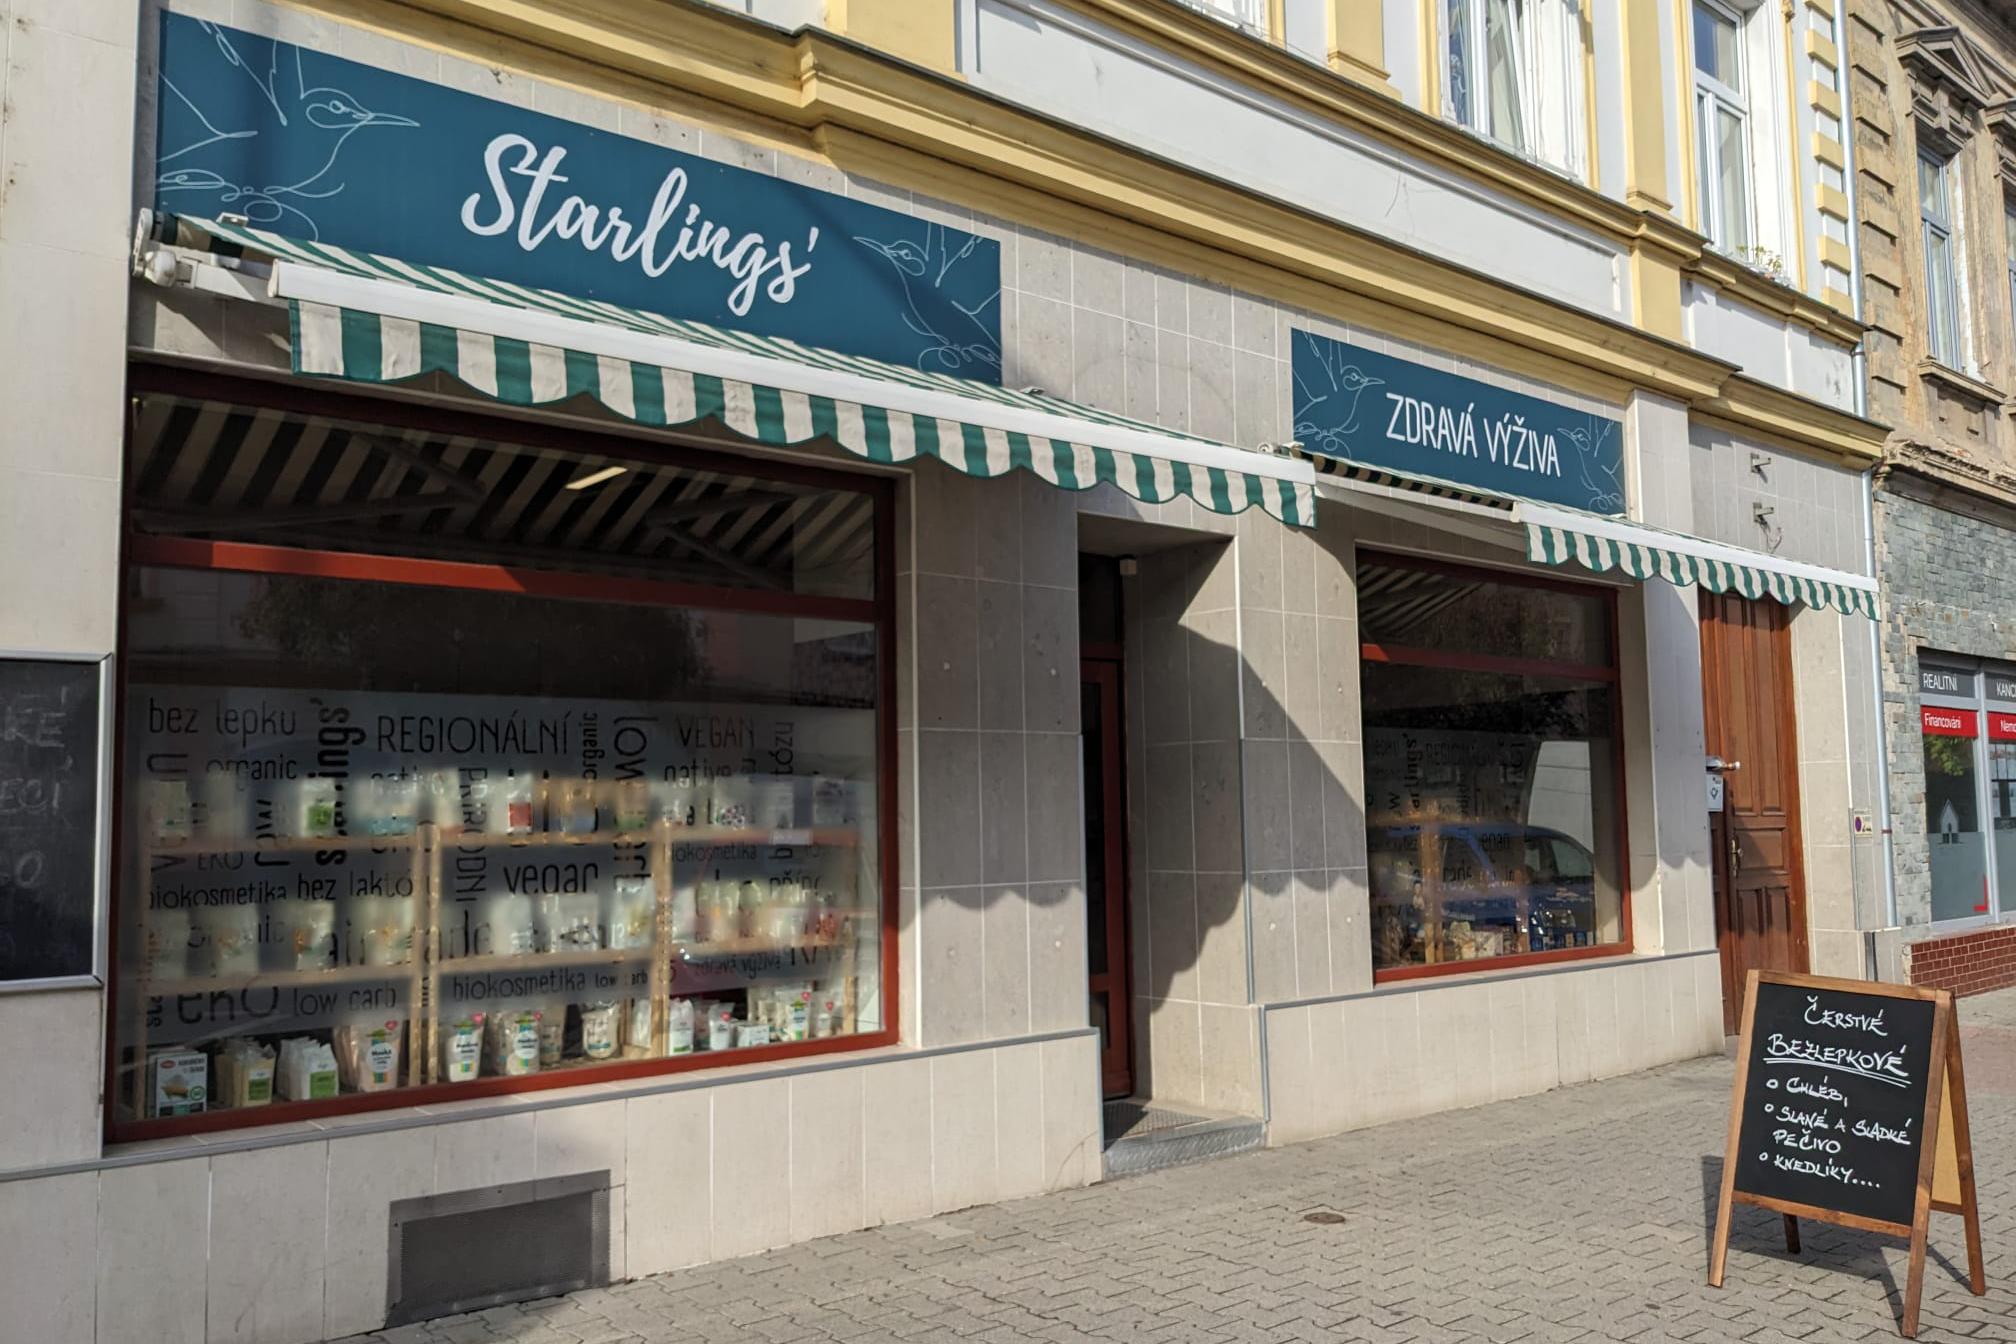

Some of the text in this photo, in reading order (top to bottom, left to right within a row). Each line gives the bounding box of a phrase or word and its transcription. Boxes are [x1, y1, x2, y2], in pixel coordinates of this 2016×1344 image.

[460, 133, 820, 317] Starlings'
[1385, 392, 1561, 478] ZDRAVÁ VÝŽIVA
[1923, 672, 1958, 691] REALITNÍ
[149, 697, 297, 748] bez lepku
[377, 709, 571, 755] REGIONÁLNÍ
[673, 711, 756, 749] VEGAN
[293, 987, 339, 1018] low
[349, 980, 398, 1015] carb
[1804, 995, 1888, 1036] ČERSTVÉ
[1767, 1033, 1908, 1077] BEZLEPKOVÉ
[1773, 1129, 1841, 1153] PEČIVO
[1776, 1108, 1912, 1145] SLANÉ A SLADKÉ
